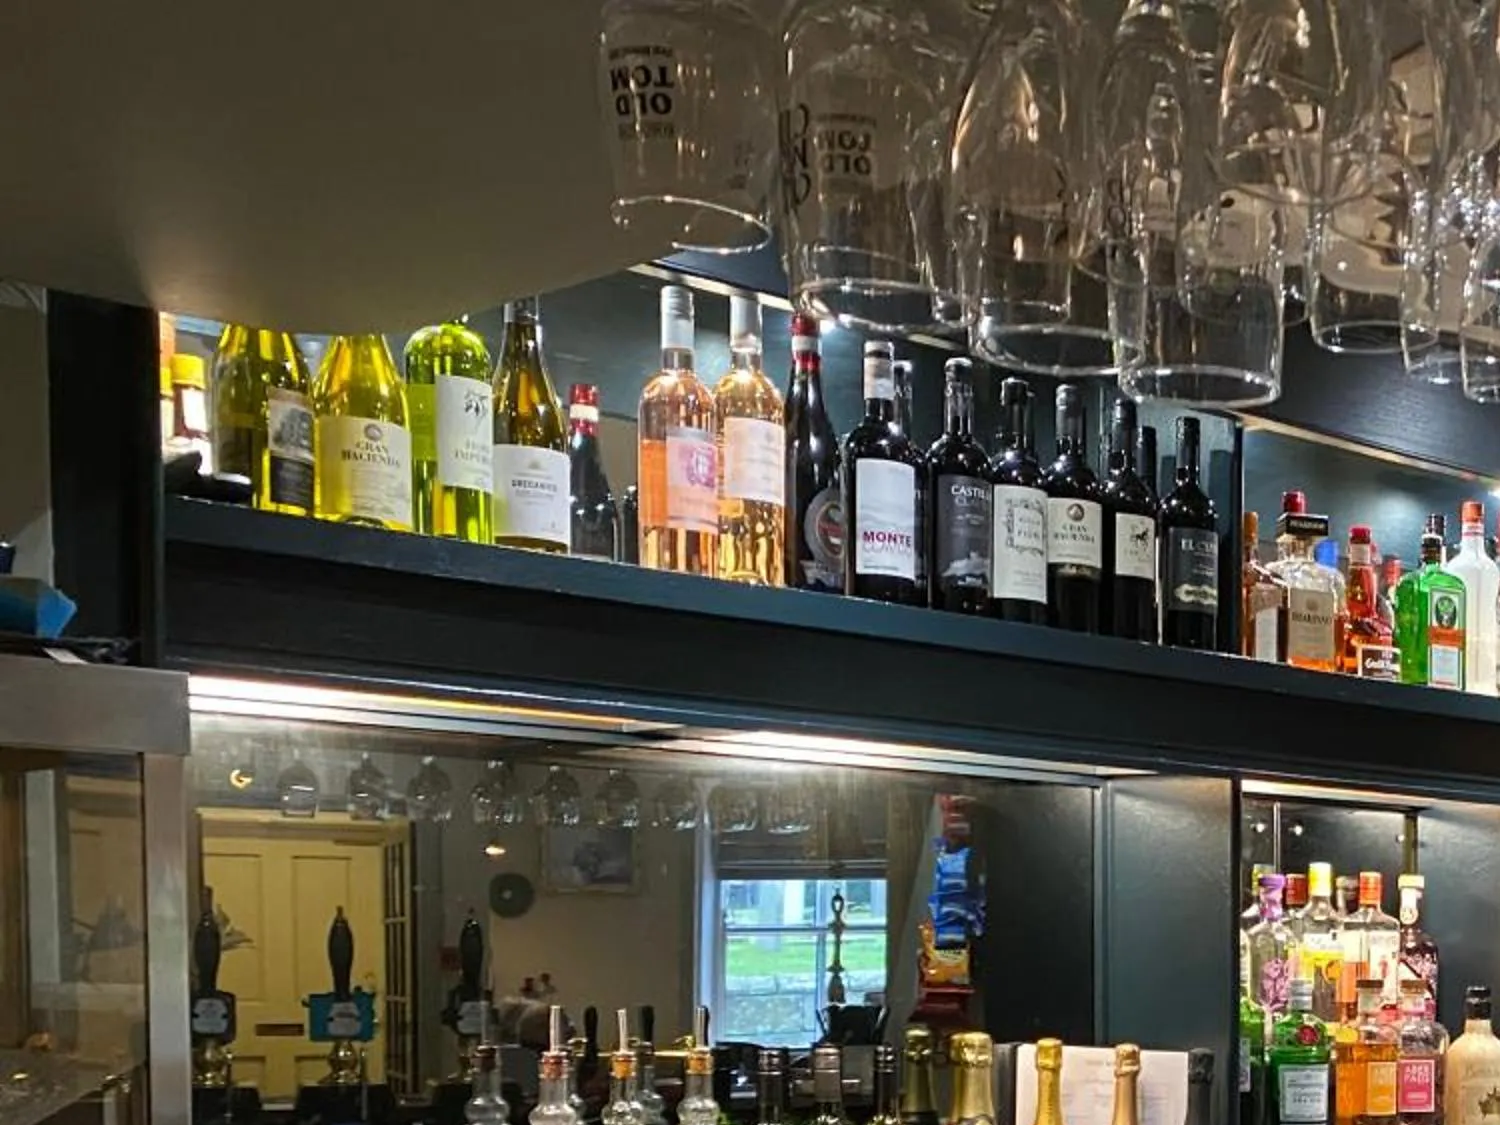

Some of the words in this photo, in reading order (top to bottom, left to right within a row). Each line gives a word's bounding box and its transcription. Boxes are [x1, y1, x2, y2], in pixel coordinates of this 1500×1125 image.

[609, 64, 675, 92] TOM
[615, 92, 673, 116] OLD
[862, 530, 912, 549] MONTE
